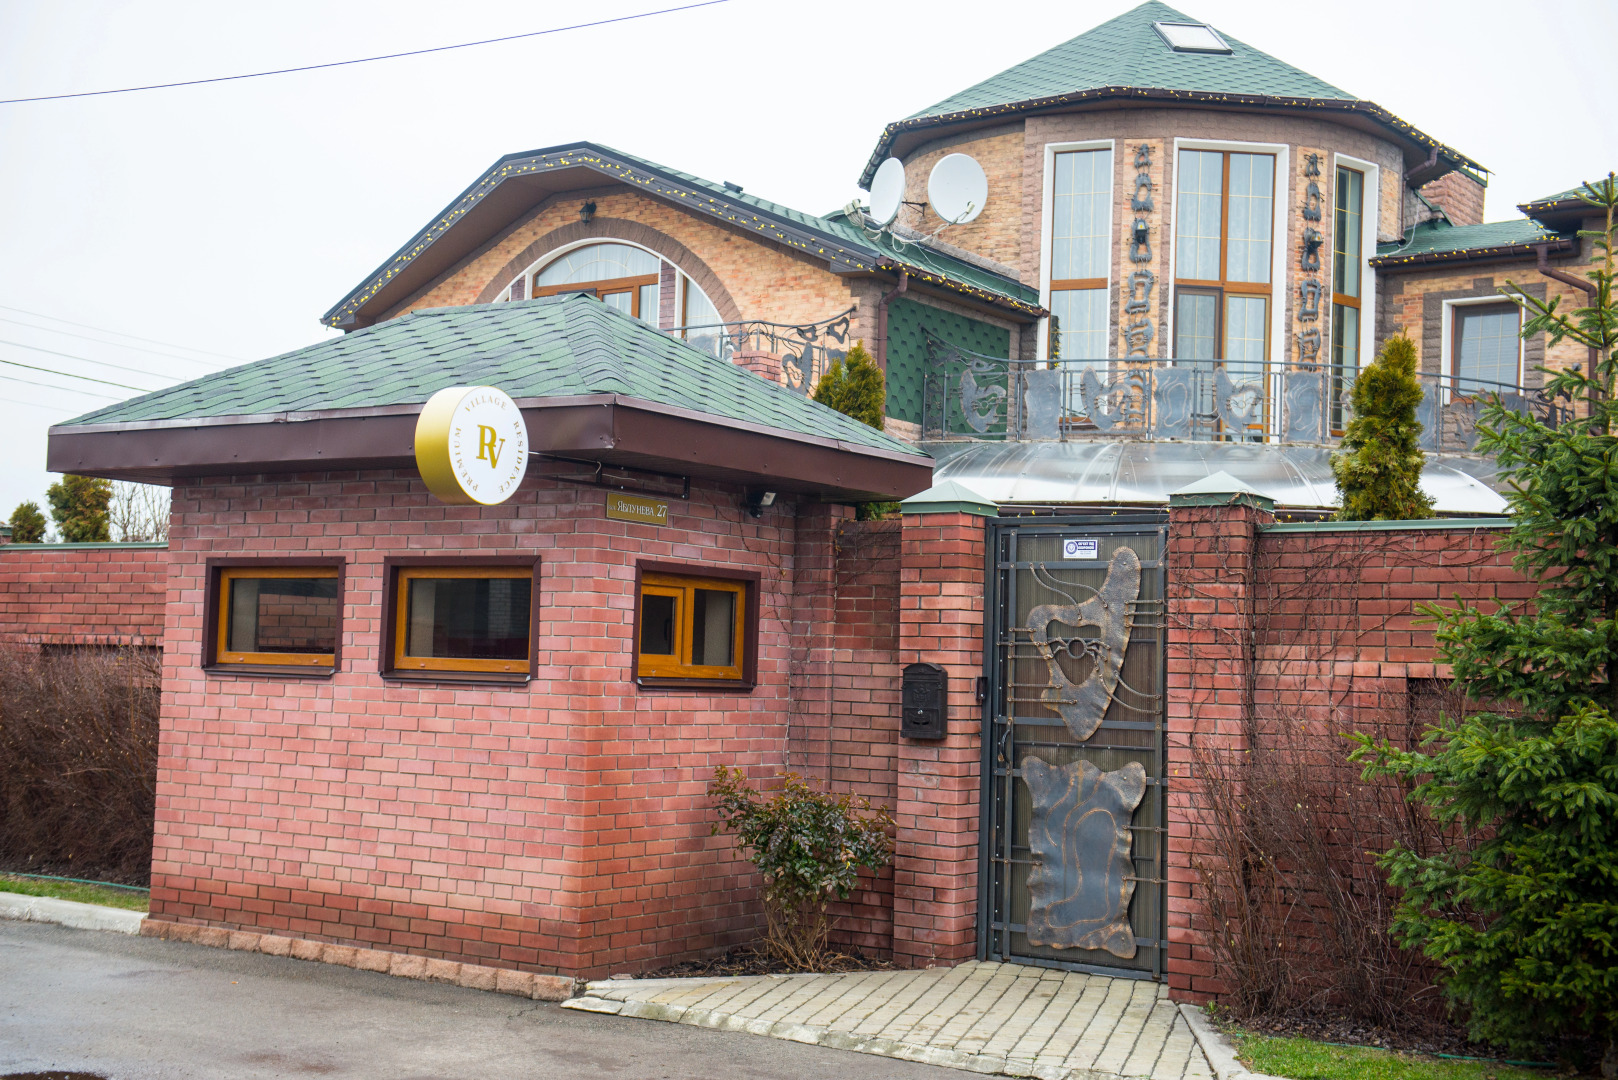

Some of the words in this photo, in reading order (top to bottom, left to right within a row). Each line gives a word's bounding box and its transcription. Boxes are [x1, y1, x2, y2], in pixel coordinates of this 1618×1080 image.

[465, 395, 507, 412] VILLAGE
[454, 427, 479, 492] PREMIUM
[499, 421, 524, 494] RESIDENCE
[656, 504, 668, 518] 27
